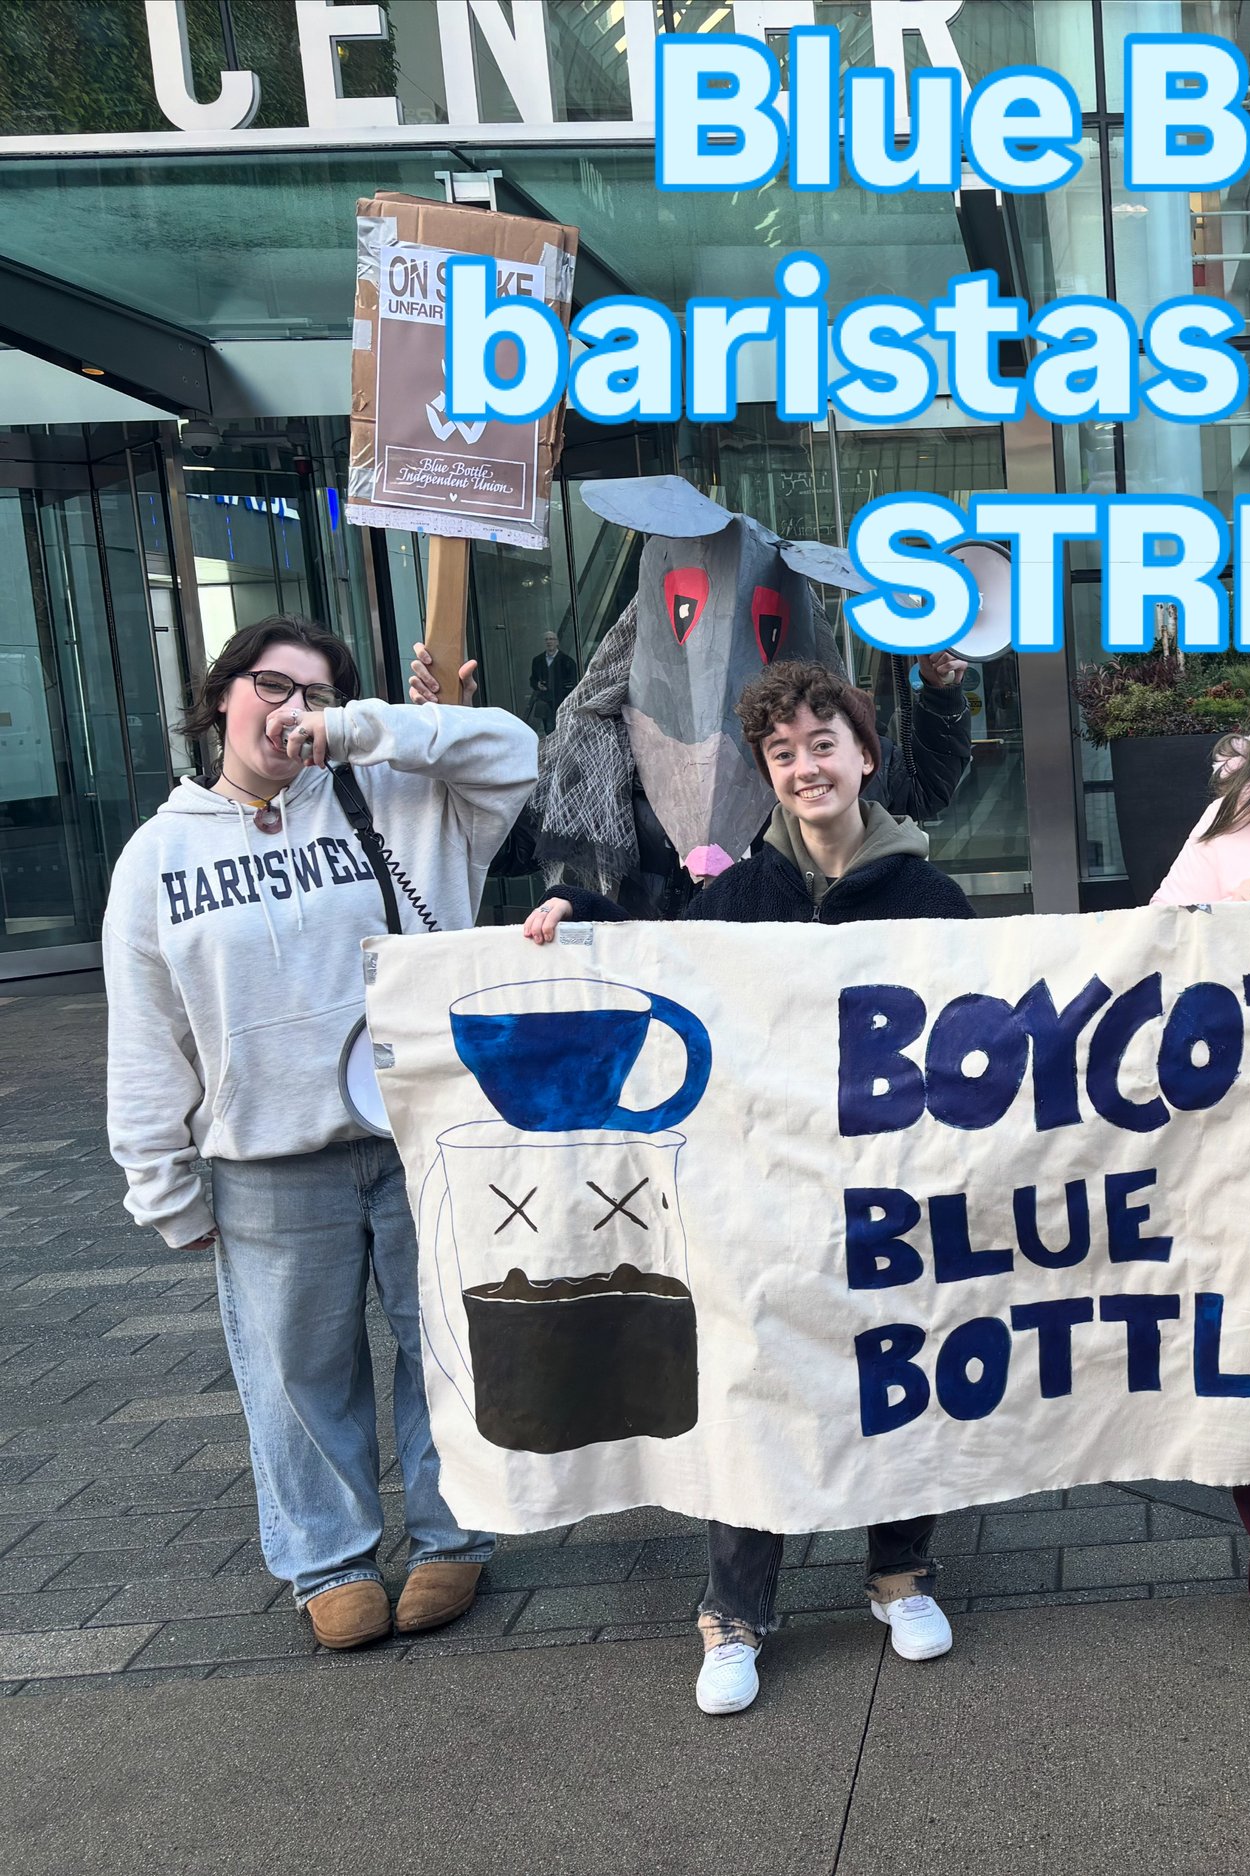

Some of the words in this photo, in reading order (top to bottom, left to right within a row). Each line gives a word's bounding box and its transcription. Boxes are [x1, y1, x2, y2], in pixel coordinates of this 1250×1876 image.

[388, 256, 428, 299] ON
[388, 299, 443, 319] UNFAIR
[396, 467, 469, 489] Independent
[471, 477, 513, 493] Union
[417, 457, 449, 473] Blue
[449, 462, 493, 478] Bottle
[844, 1168, 1172, 1290] BLUE
